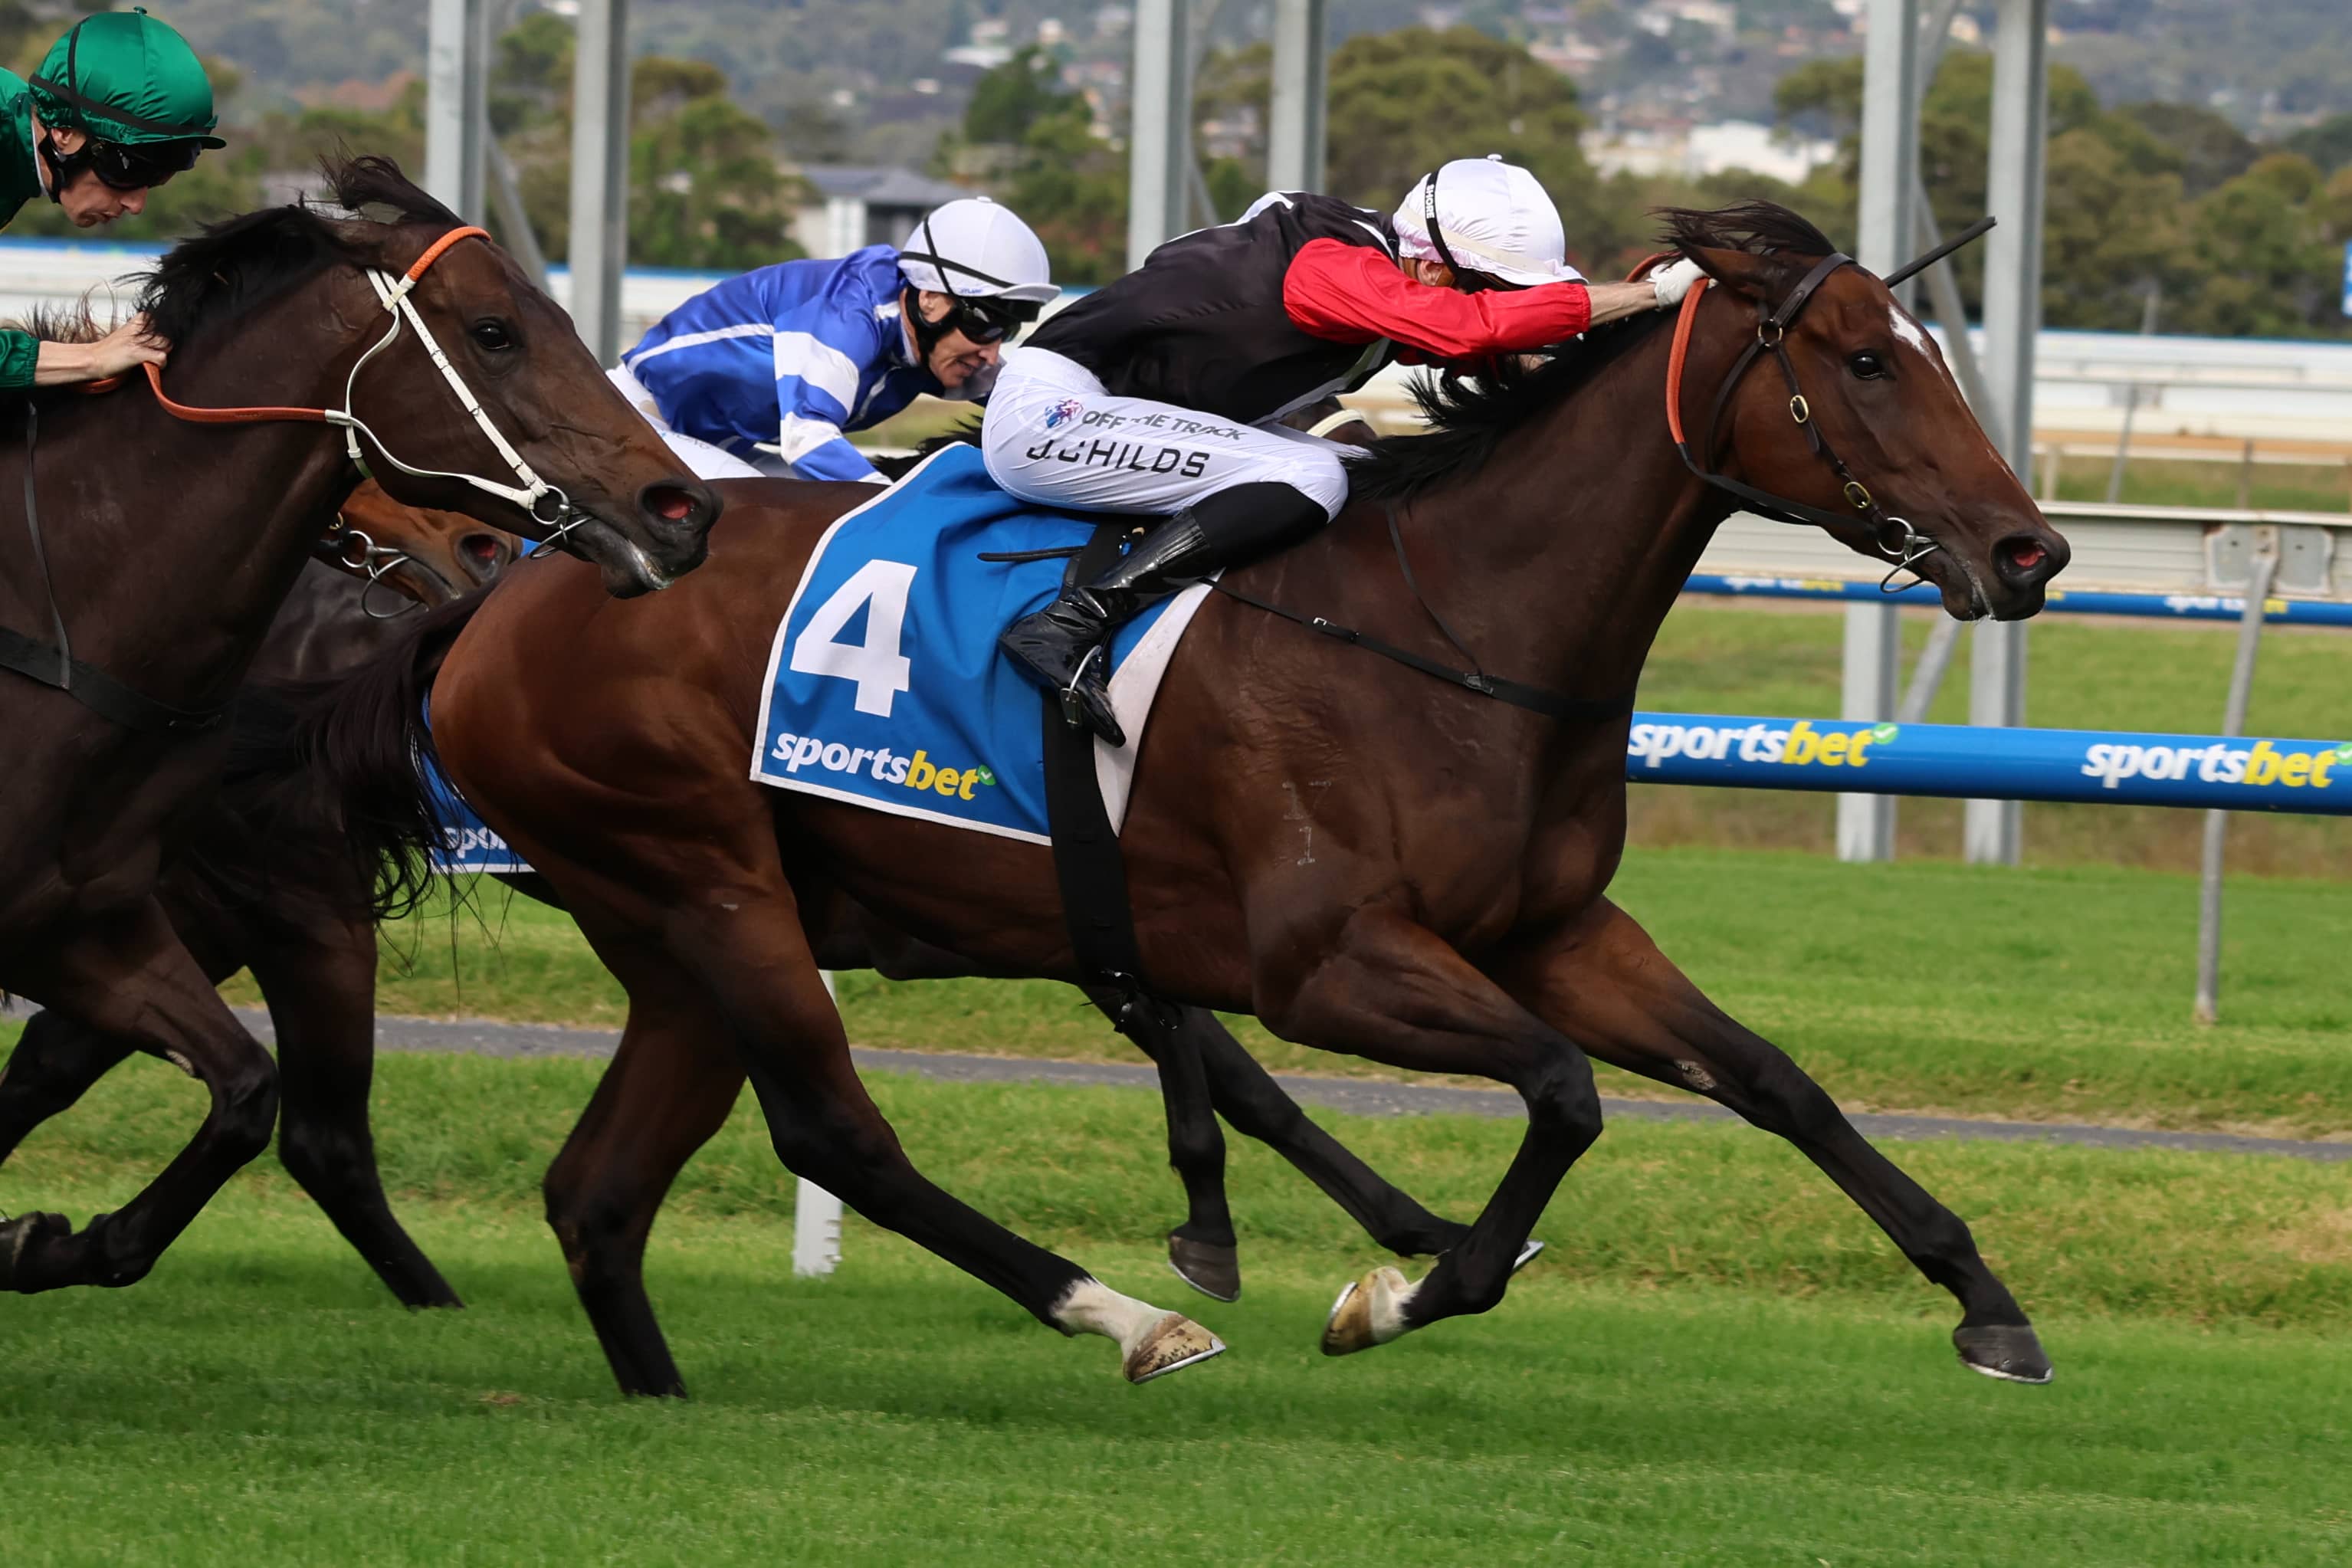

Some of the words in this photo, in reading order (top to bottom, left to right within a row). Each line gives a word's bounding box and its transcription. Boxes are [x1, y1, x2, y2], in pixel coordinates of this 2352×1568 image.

[1425, 184, 1435, 219] SHORE
[1082, 410, 1127, 429] OFF
[1171, 418, 1248, 440] TRACK
[789, 559, 918, 718] 4
[771, 732, 979, 801] sportsbet
[1627, 721, 1874, 768] sportsbet
[2081, 740, 2337, 789] sportsbet
